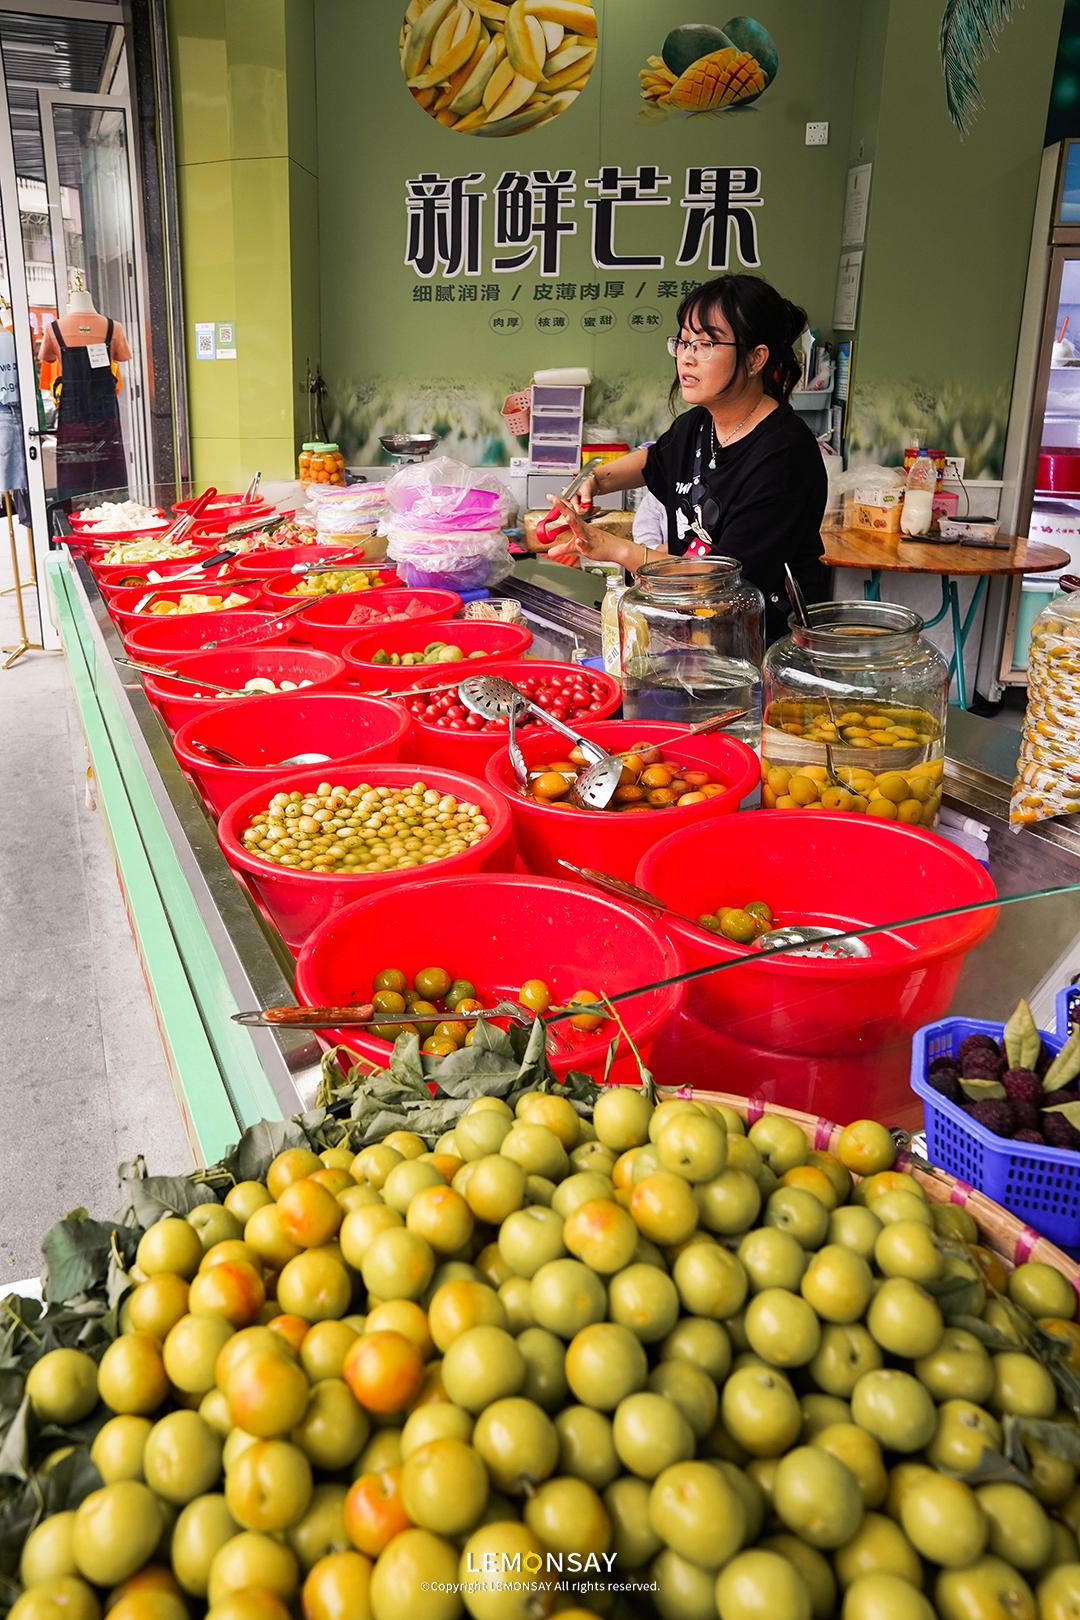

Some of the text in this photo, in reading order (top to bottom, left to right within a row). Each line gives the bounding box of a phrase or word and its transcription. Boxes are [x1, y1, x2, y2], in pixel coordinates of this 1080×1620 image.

[404, 165, 764, 278] 新鲜芒果
[412, 284, 500, 302] 细腻润滑
[532, 281, 625, 301] 皮薄肉厚
[493, 314, 659, 328] 肉厚 核薄 蜜甜 柔软
